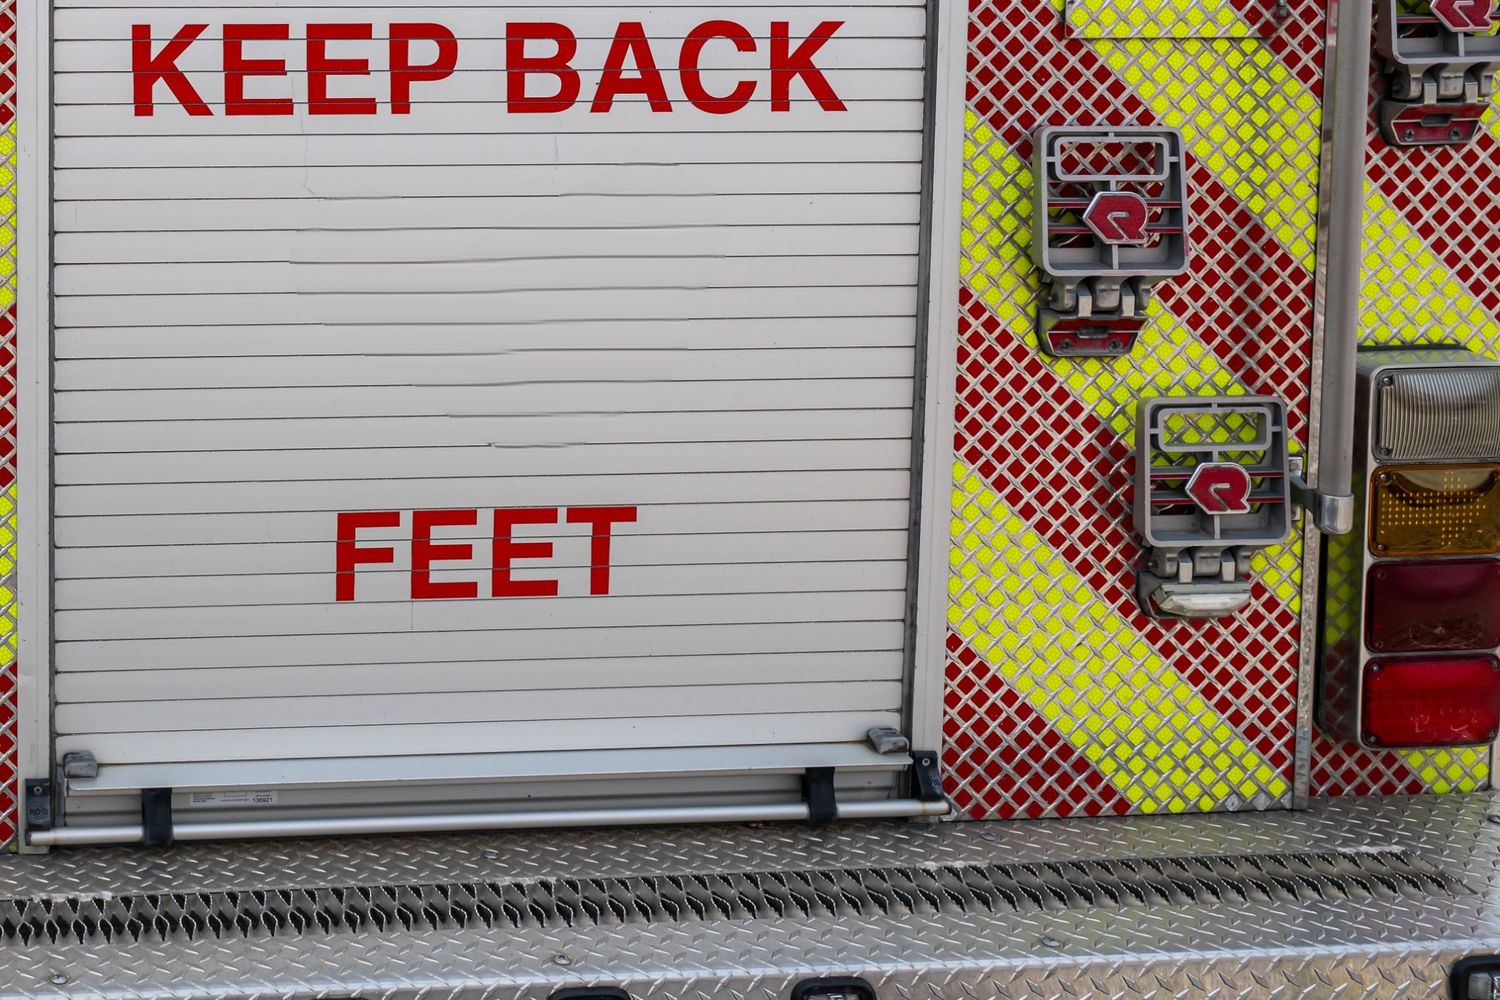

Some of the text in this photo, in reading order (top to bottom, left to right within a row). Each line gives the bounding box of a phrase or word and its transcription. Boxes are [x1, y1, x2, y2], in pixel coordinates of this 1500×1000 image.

[131, 20, 848, 117] KEEP BACK
[336, 506, 638, 601] FEET
